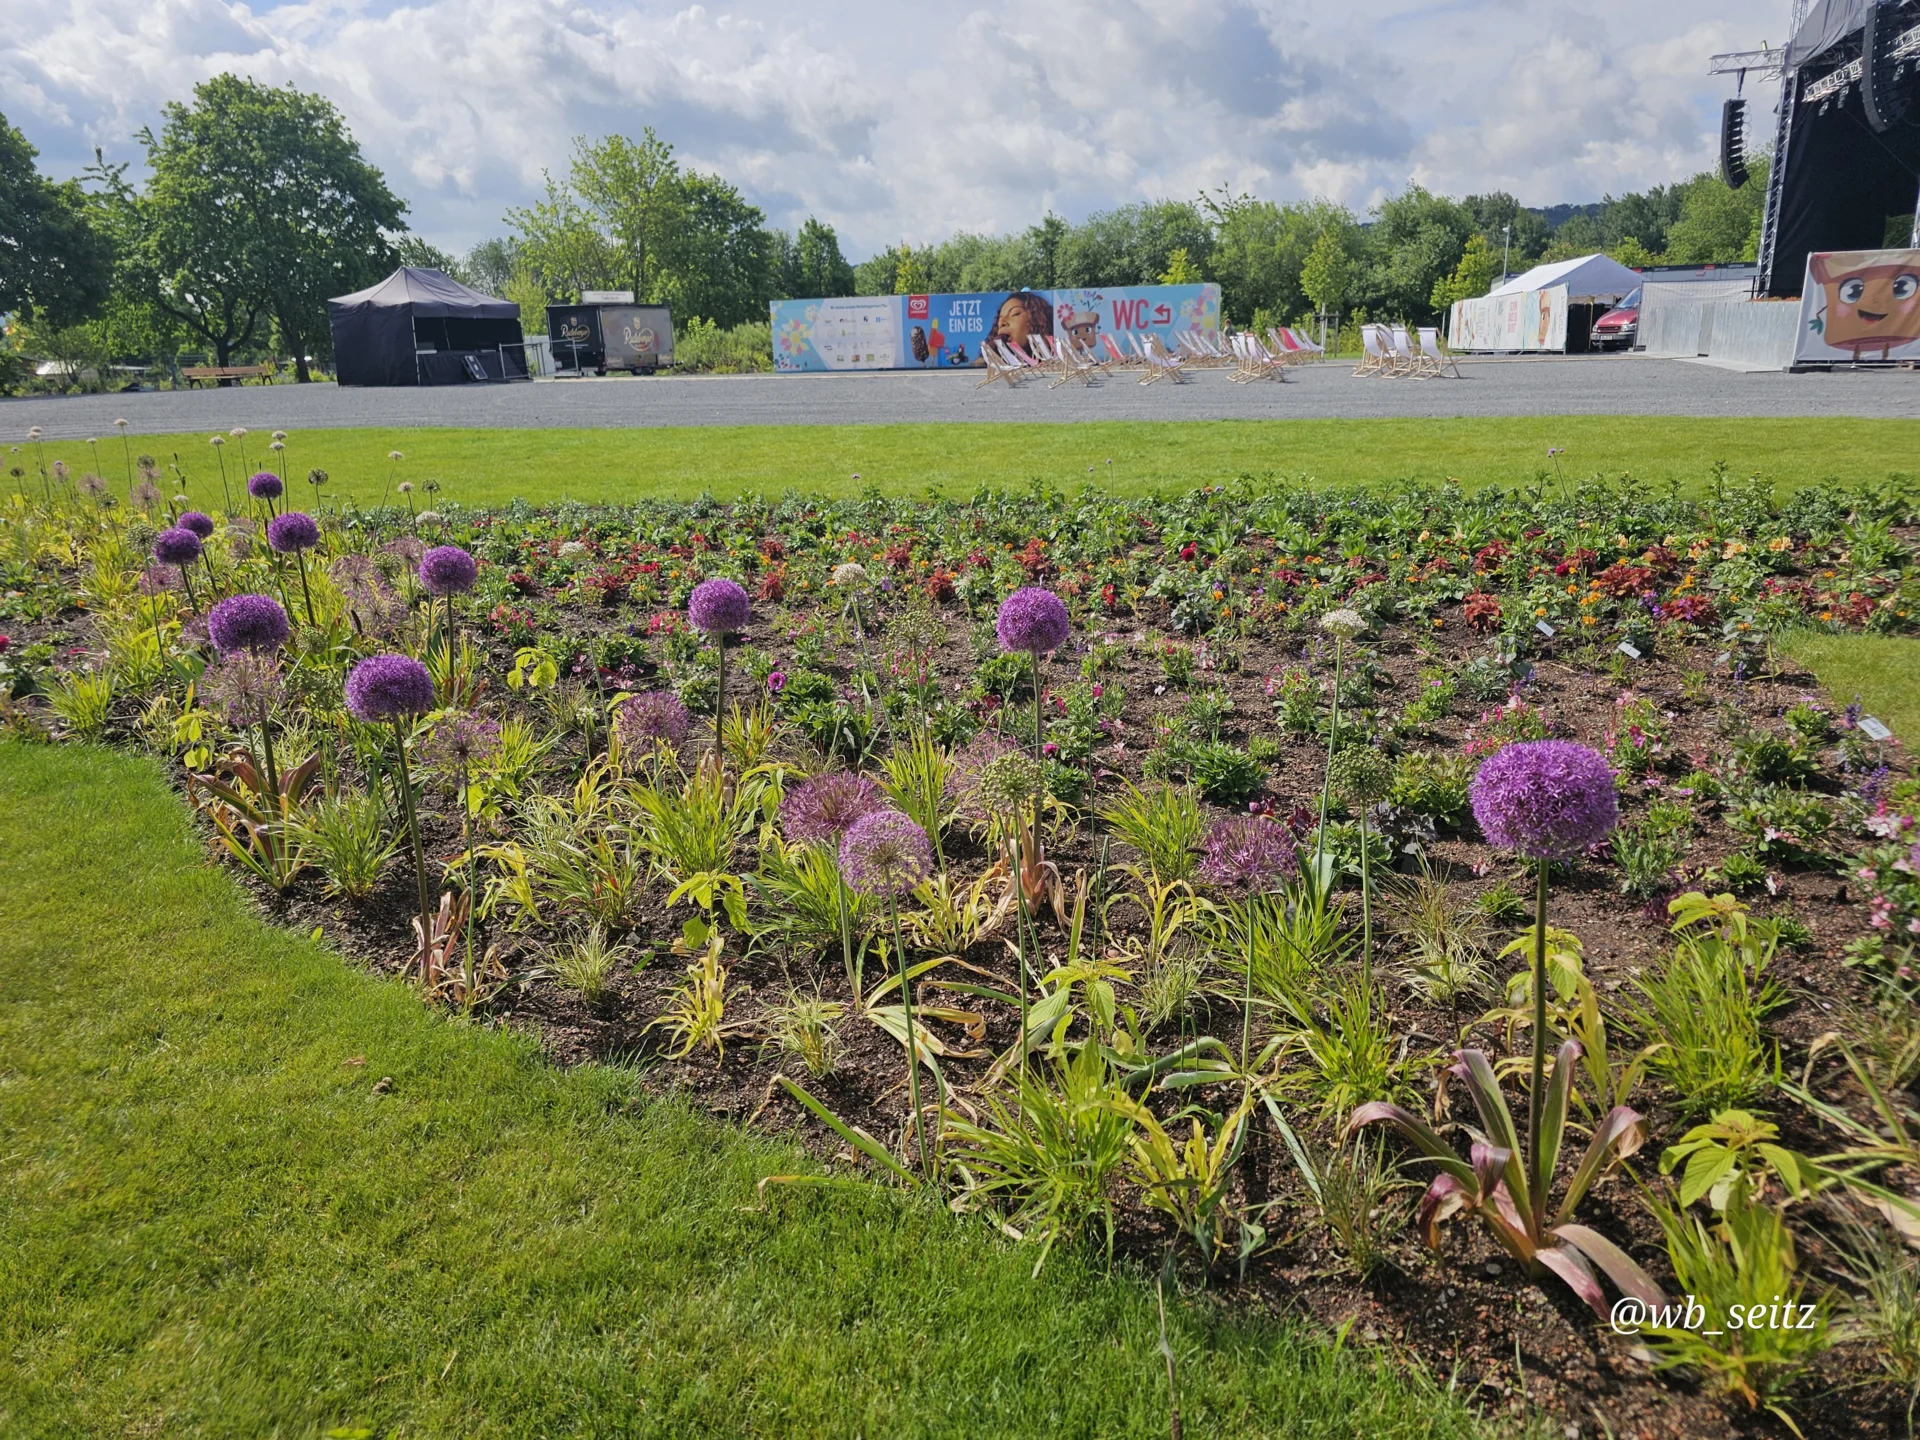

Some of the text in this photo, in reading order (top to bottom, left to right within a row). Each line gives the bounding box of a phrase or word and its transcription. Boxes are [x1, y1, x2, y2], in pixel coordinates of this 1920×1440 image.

[949, 300, 982, 316] JETZT
[1112, 299, 1150, 331] WC
[949, 317, 983, 333] EIN EIS
